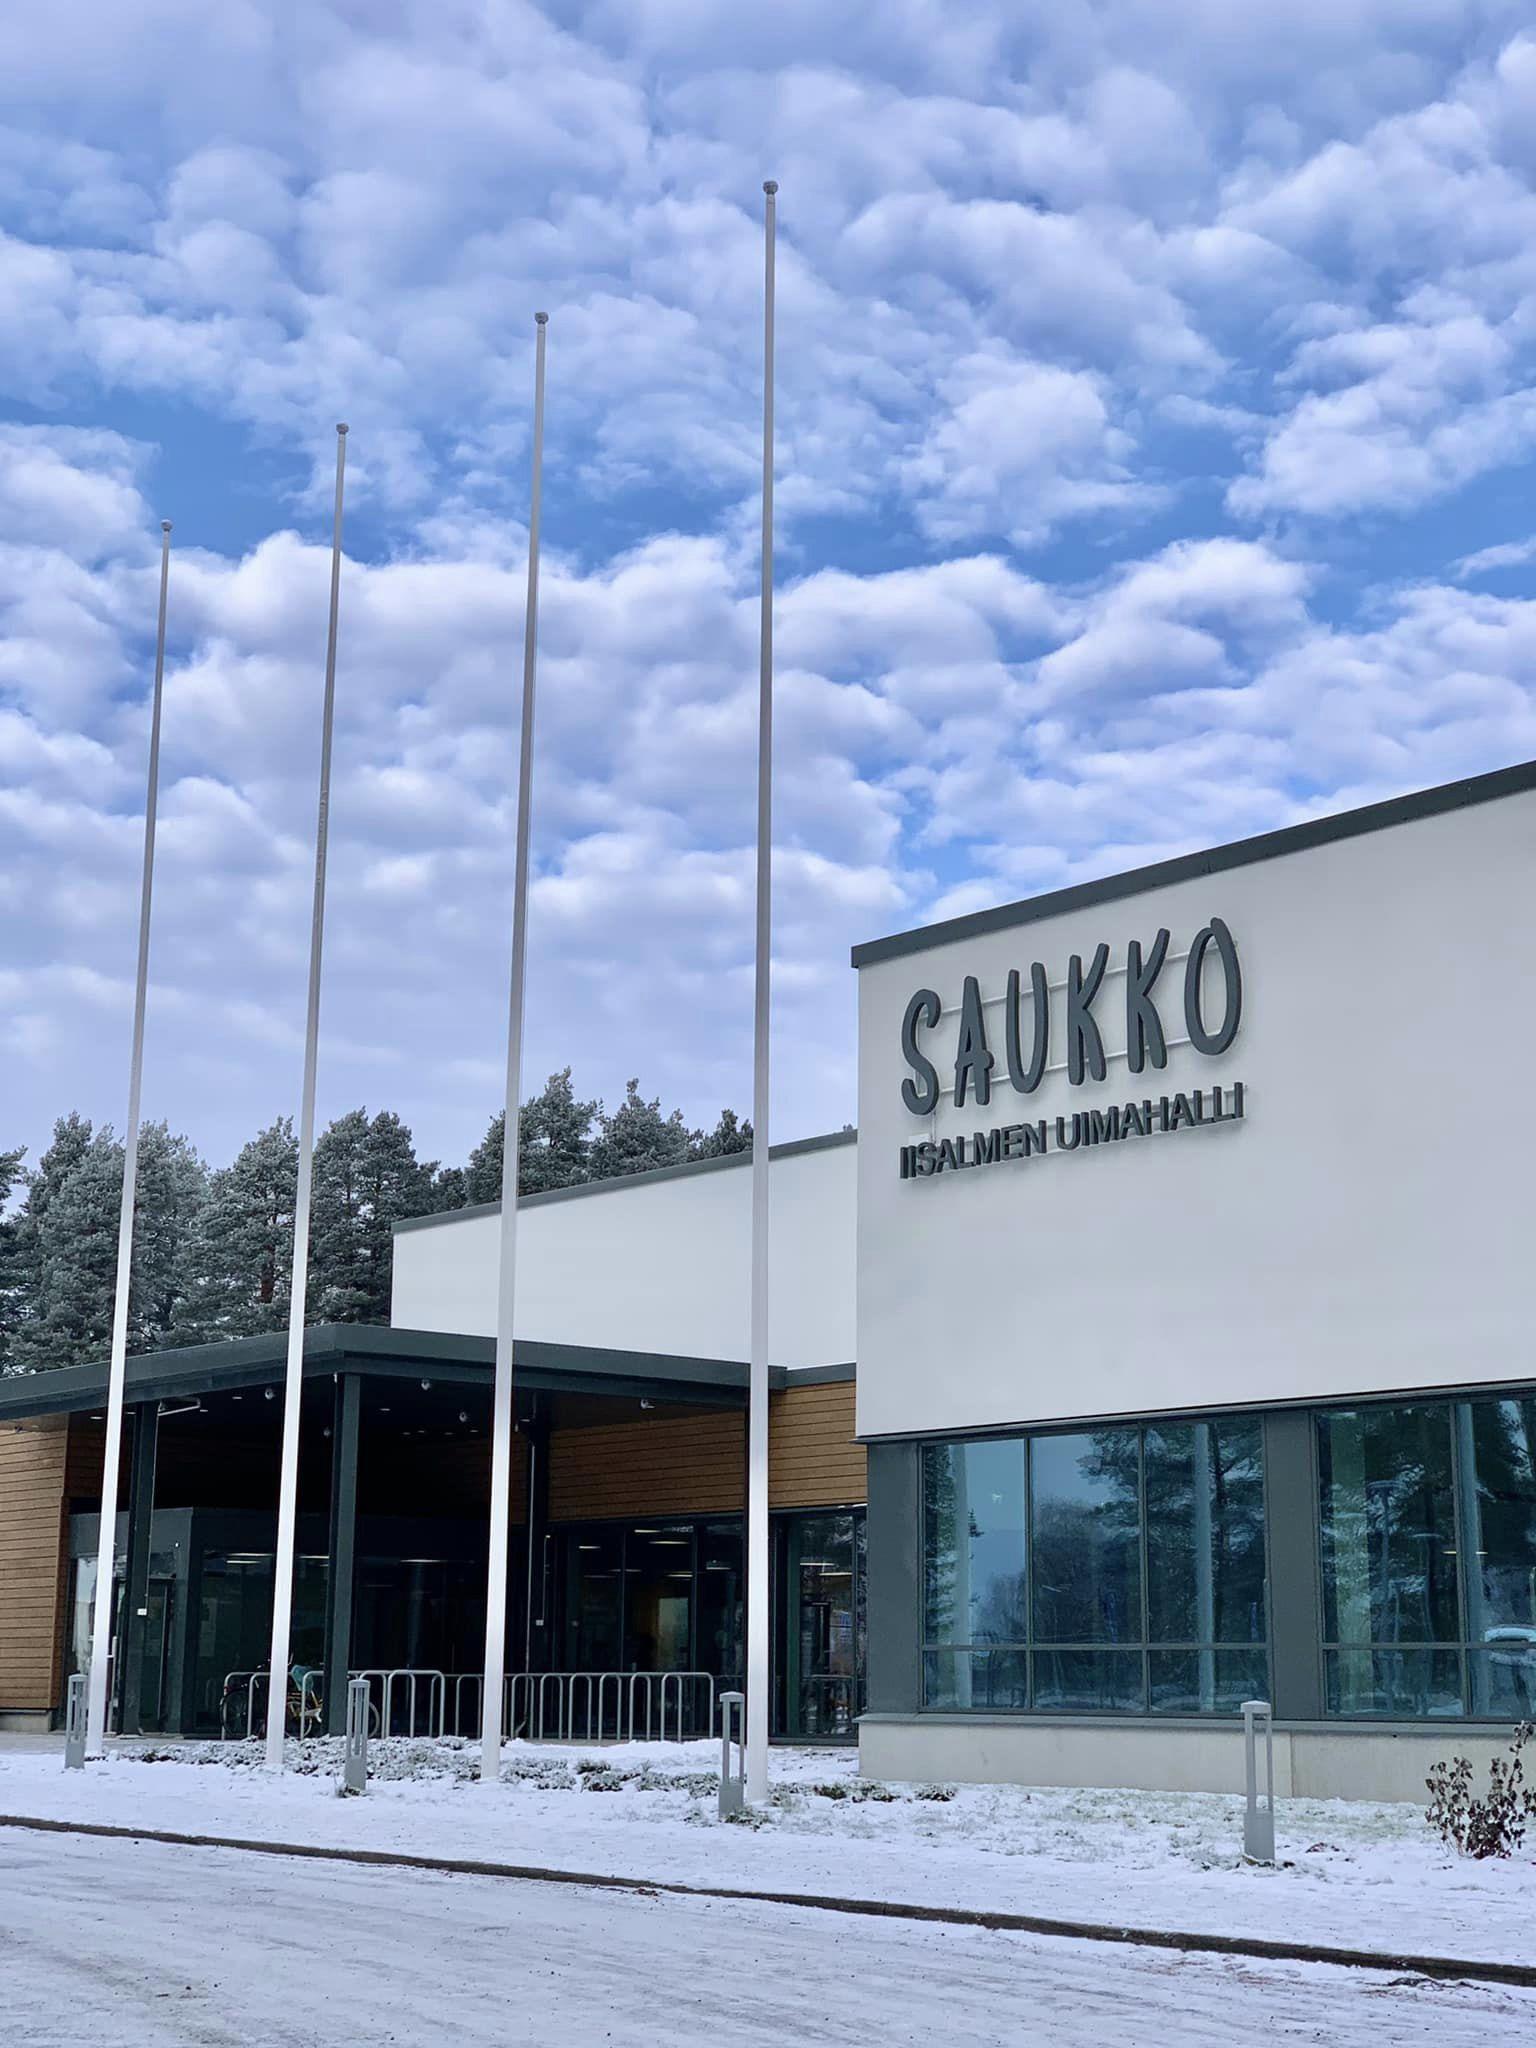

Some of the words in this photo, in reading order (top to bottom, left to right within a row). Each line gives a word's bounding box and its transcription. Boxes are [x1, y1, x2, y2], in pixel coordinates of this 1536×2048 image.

[902, 917, 1242, 1115] SAUKKO
[900, 1120, 1047, 1179] IISALMEN
[1056, 1082, 1244, 1150] UIMAHALLI
